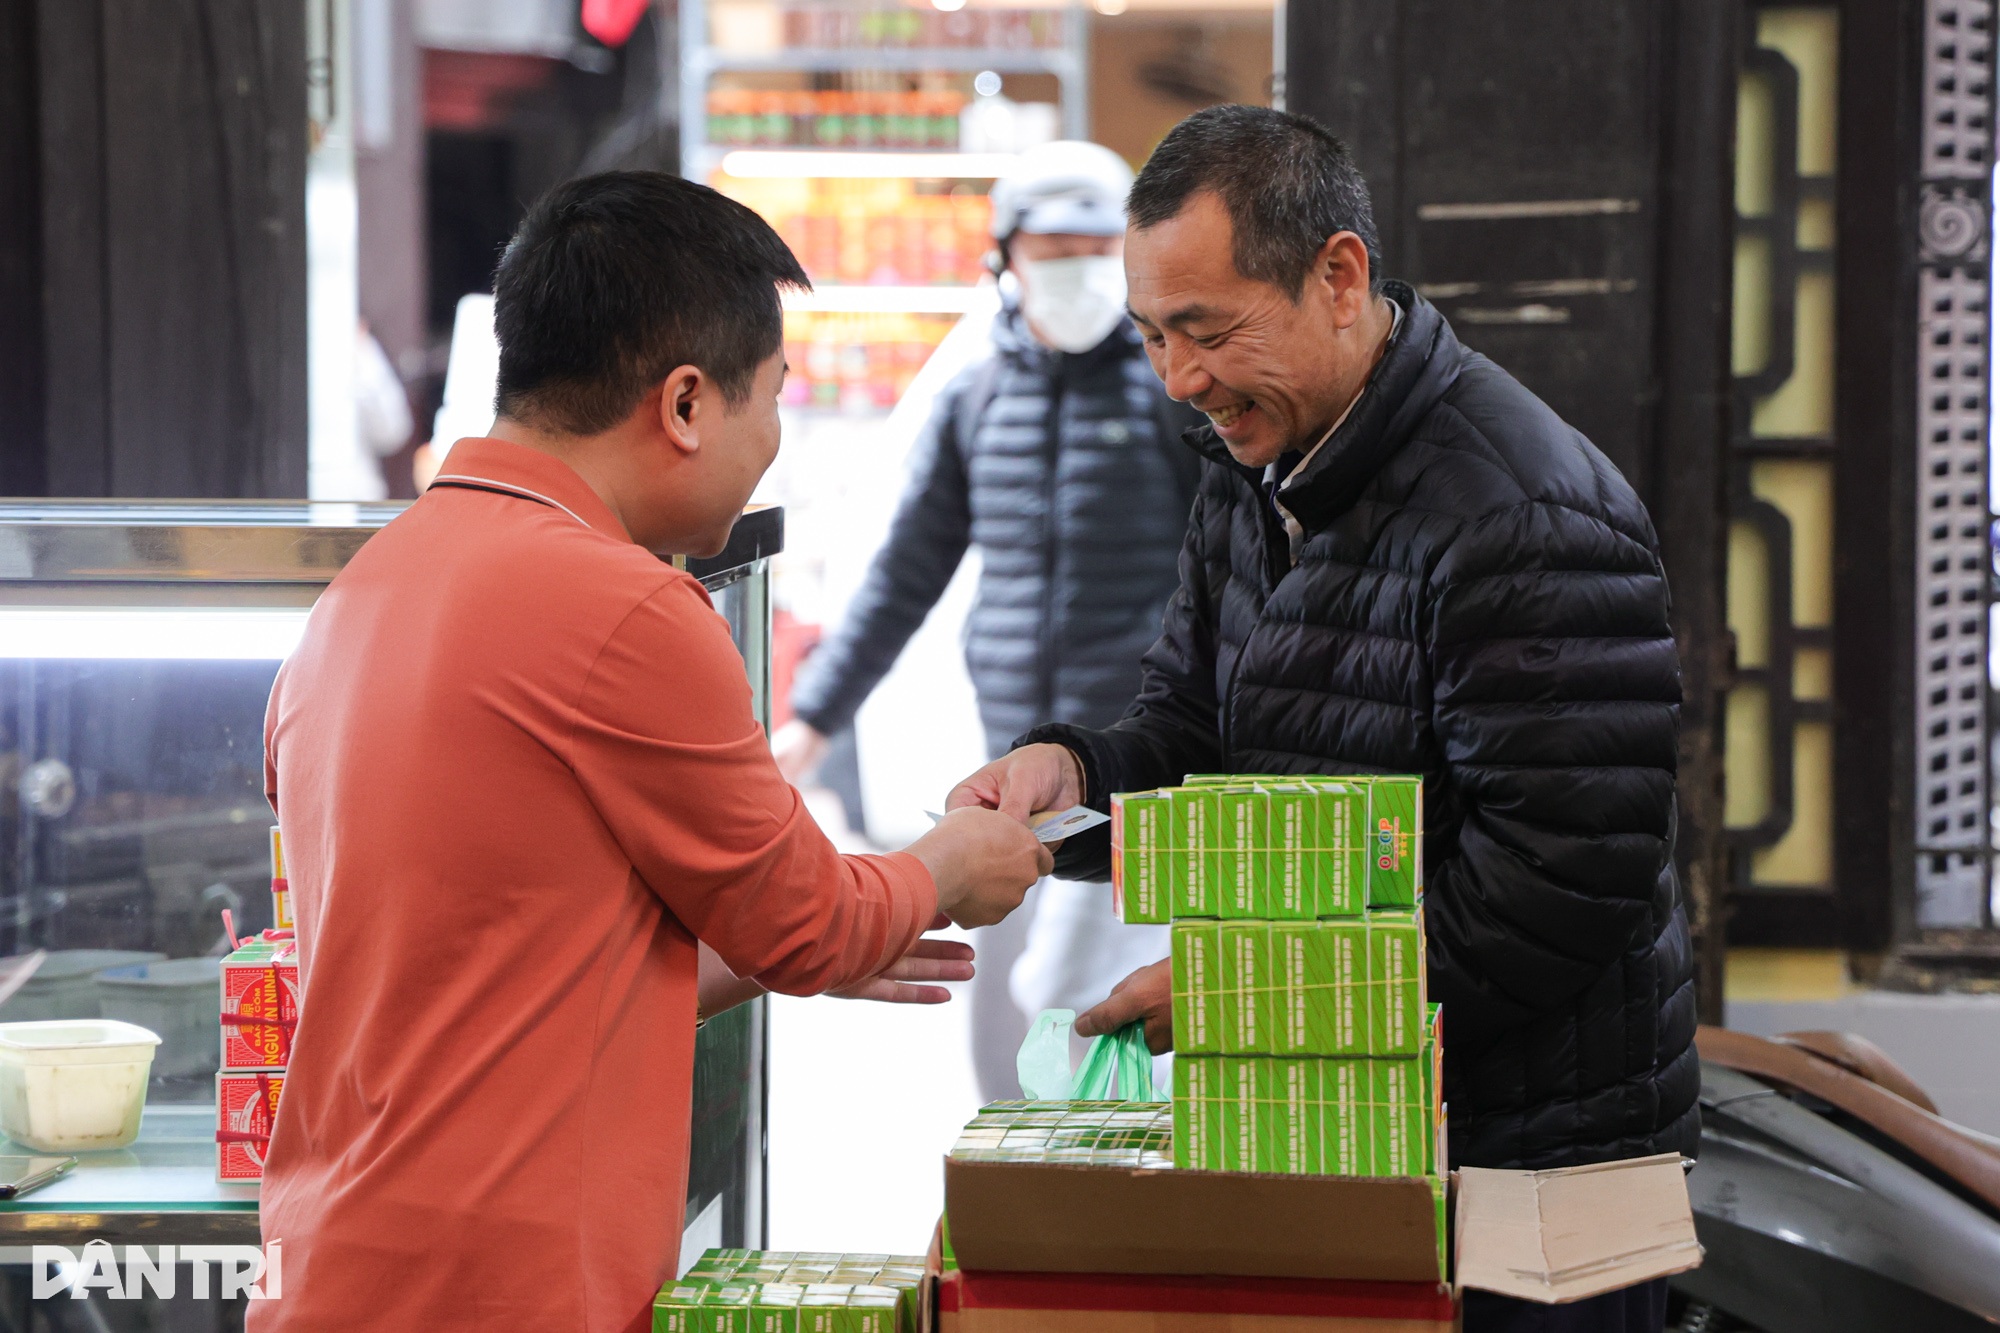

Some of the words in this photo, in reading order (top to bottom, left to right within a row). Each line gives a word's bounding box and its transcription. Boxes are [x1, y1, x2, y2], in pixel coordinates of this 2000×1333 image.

[1378, 817, 1394, 870] OCOP
[251, 988, 261, 1013] CỐM
[264, 969, 278, 1003] NINH
[252, 1016, 261, 1047] BÁN
[264, 1007, 279, 1064] NGUYN
